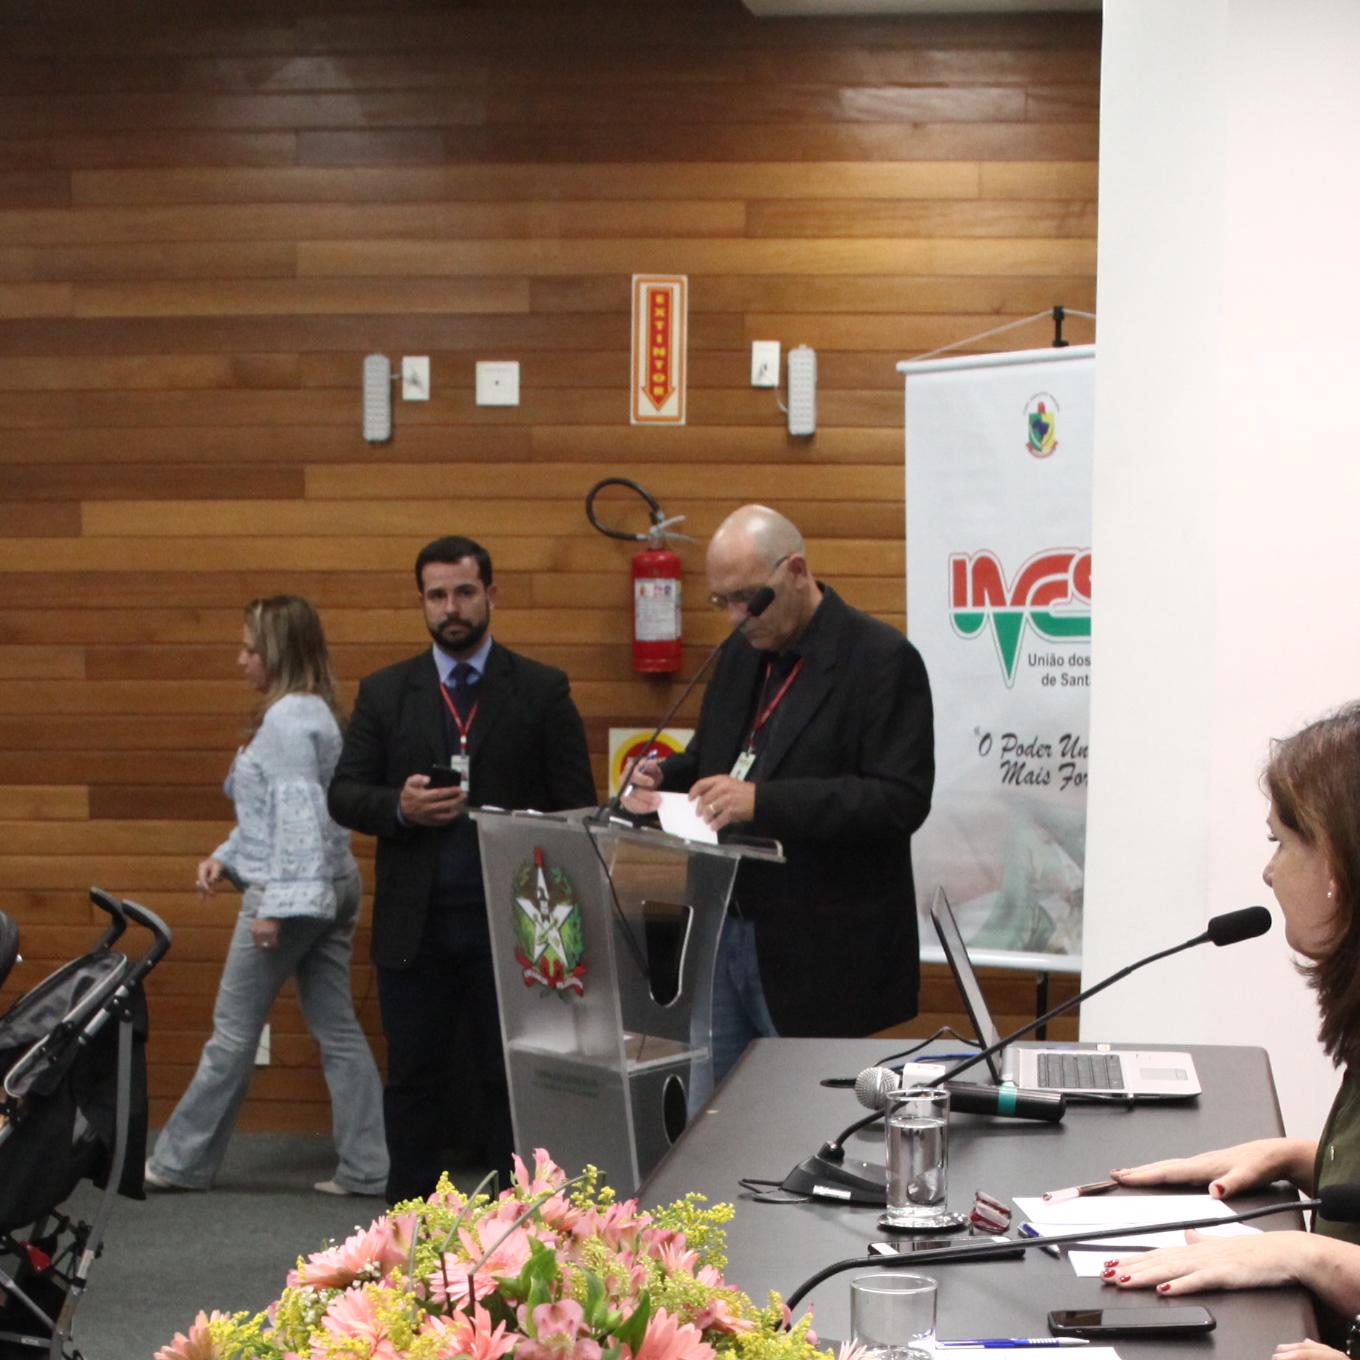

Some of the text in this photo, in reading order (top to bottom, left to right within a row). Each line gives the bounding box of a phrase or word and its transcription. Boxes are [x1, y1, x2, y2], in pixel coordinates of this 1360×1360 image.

[652, 294, 667, 396] EXTINTOR
[1028, 652, 1091, 667] União dos
[1041, 672, 1057, 687] de
[1000, 732, 1052, 759] Poder
[1000, 760, 1052, 786] Mais
